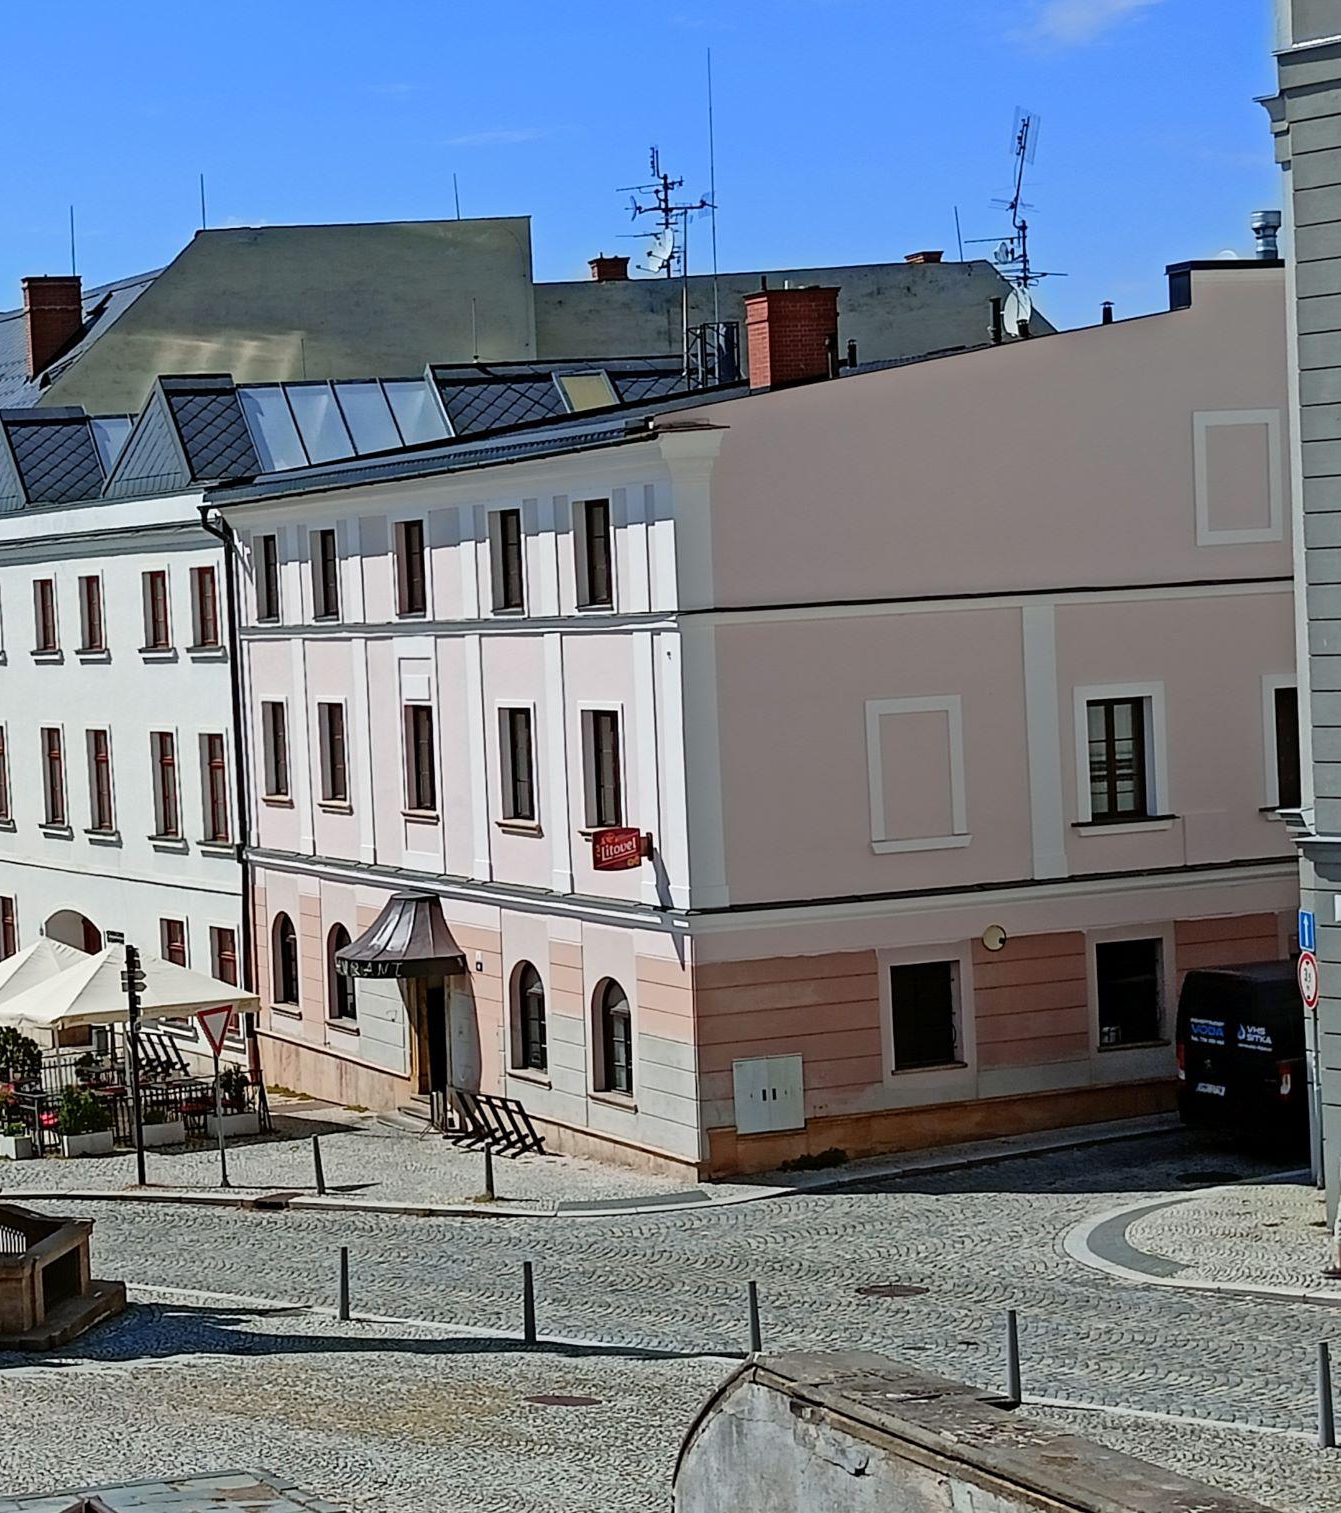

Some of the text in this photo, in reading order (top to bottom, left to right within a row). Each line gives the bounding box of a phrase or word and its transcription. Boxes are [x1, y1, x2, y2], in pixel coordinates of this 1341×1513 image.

[601, 837, 636, 861] Litovel
[1191, 1024, 1224, 1037] VODA
[1247, 1026, 1266, 1035] VHS
[1247, 1034, 1272, 1044] SITKA
